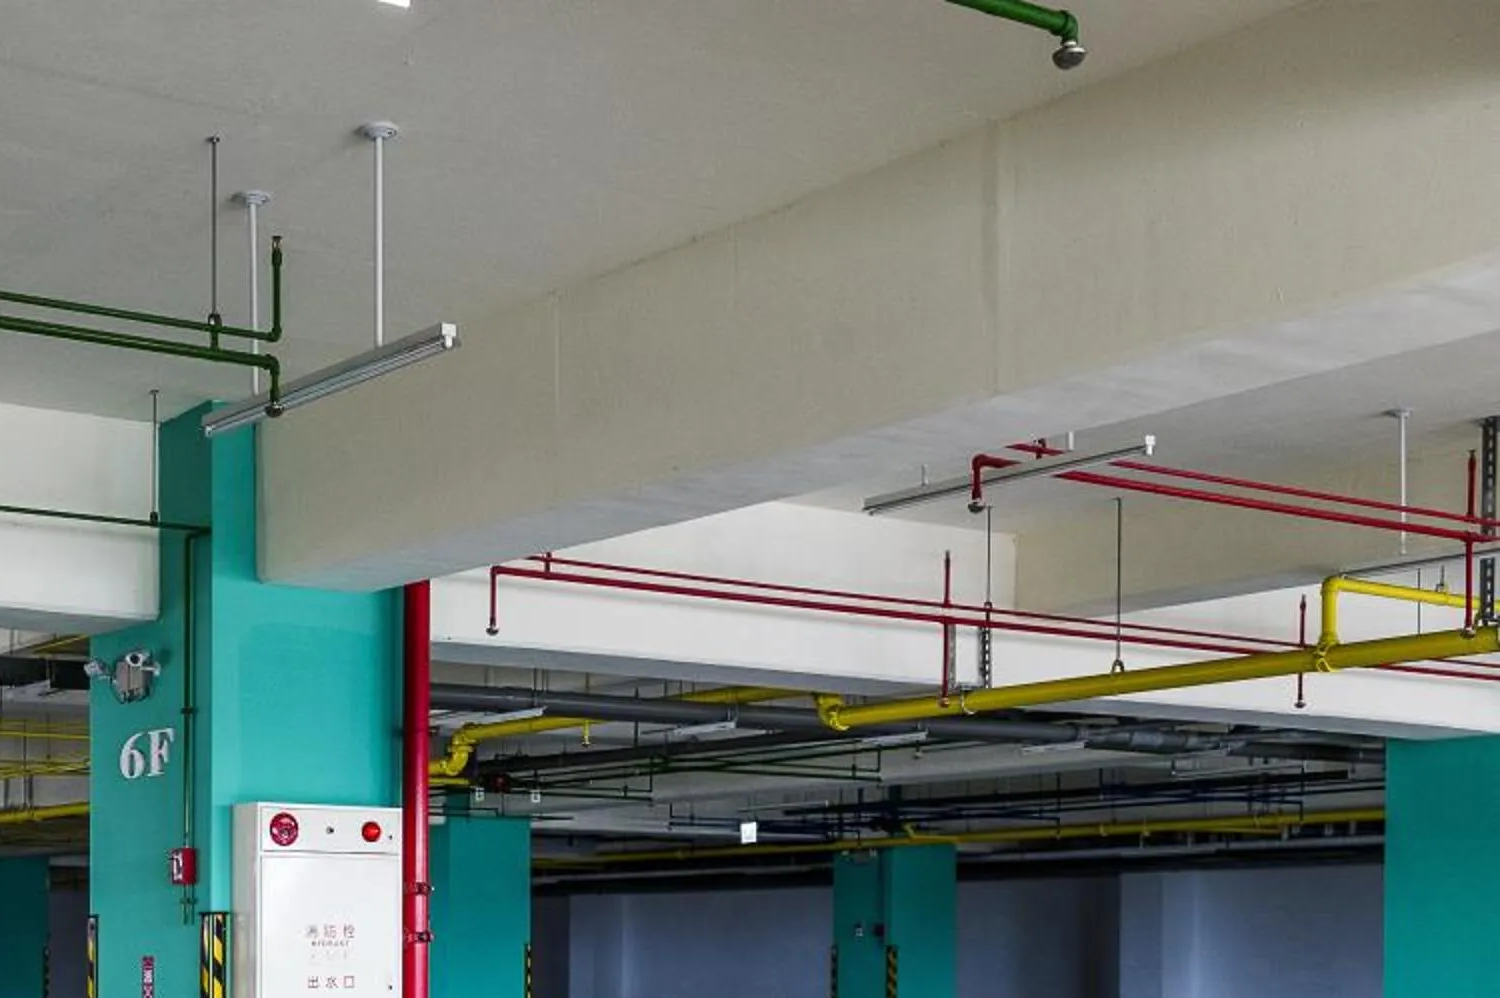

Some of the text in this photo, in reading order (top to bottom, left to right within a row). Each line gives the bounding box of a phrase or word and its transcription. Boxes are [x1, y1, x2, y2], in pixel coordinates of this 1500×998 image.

[120, 728, 174, 779] 6F
[307, 975, 355, 988] 出水口
